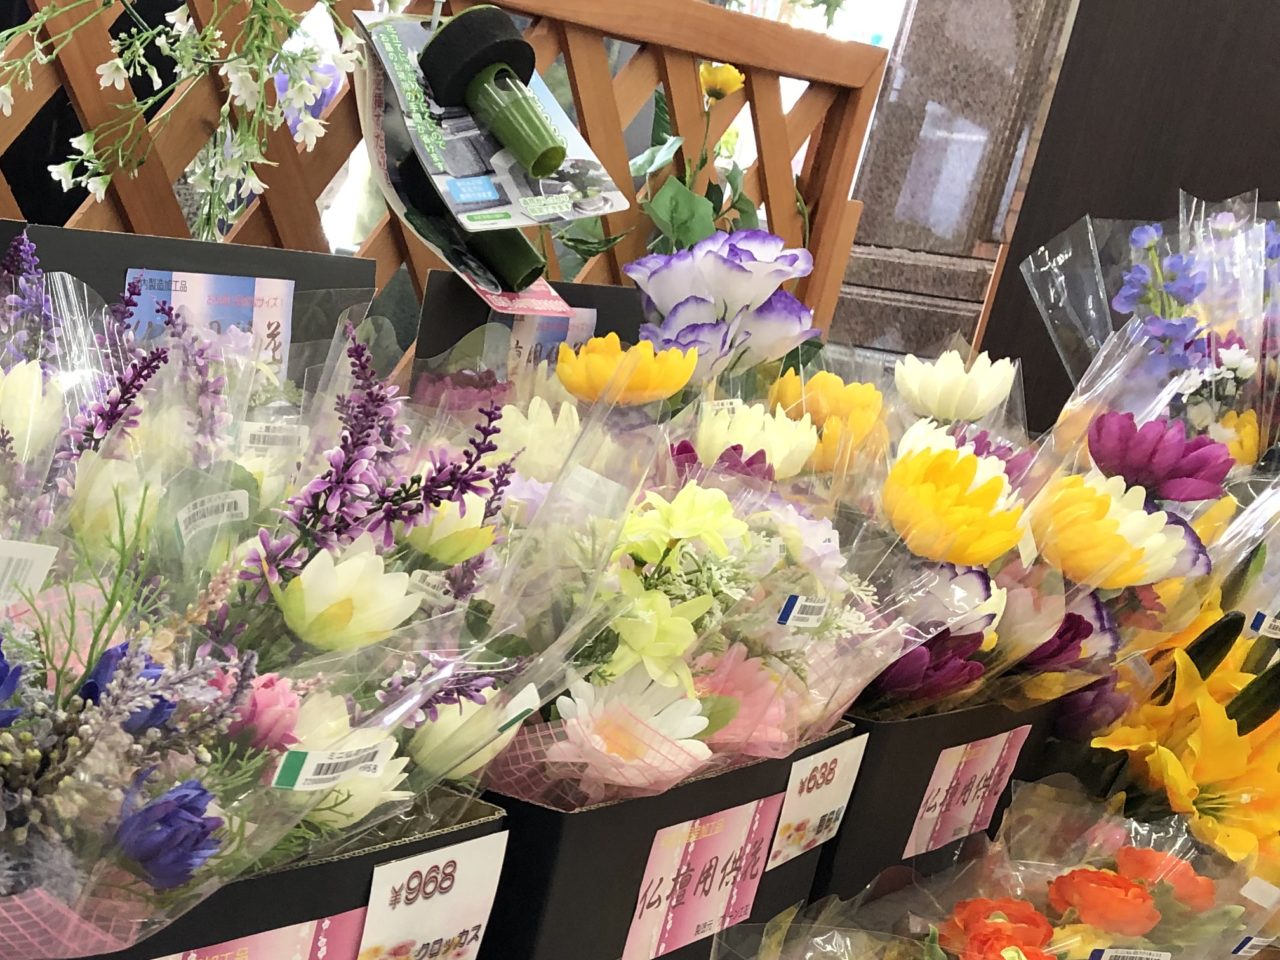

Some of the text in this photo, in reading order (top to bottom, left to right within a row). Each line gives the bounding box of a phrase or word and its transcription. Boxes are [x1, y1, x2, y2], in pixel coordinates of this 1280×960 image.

[134, 277, 188, 292] 内製造加工品
[797, 757, 839, 797] ¥638
[389, 859, 458, 911] ¥968
[637, 836, 765, 920] 仏壇用供花
